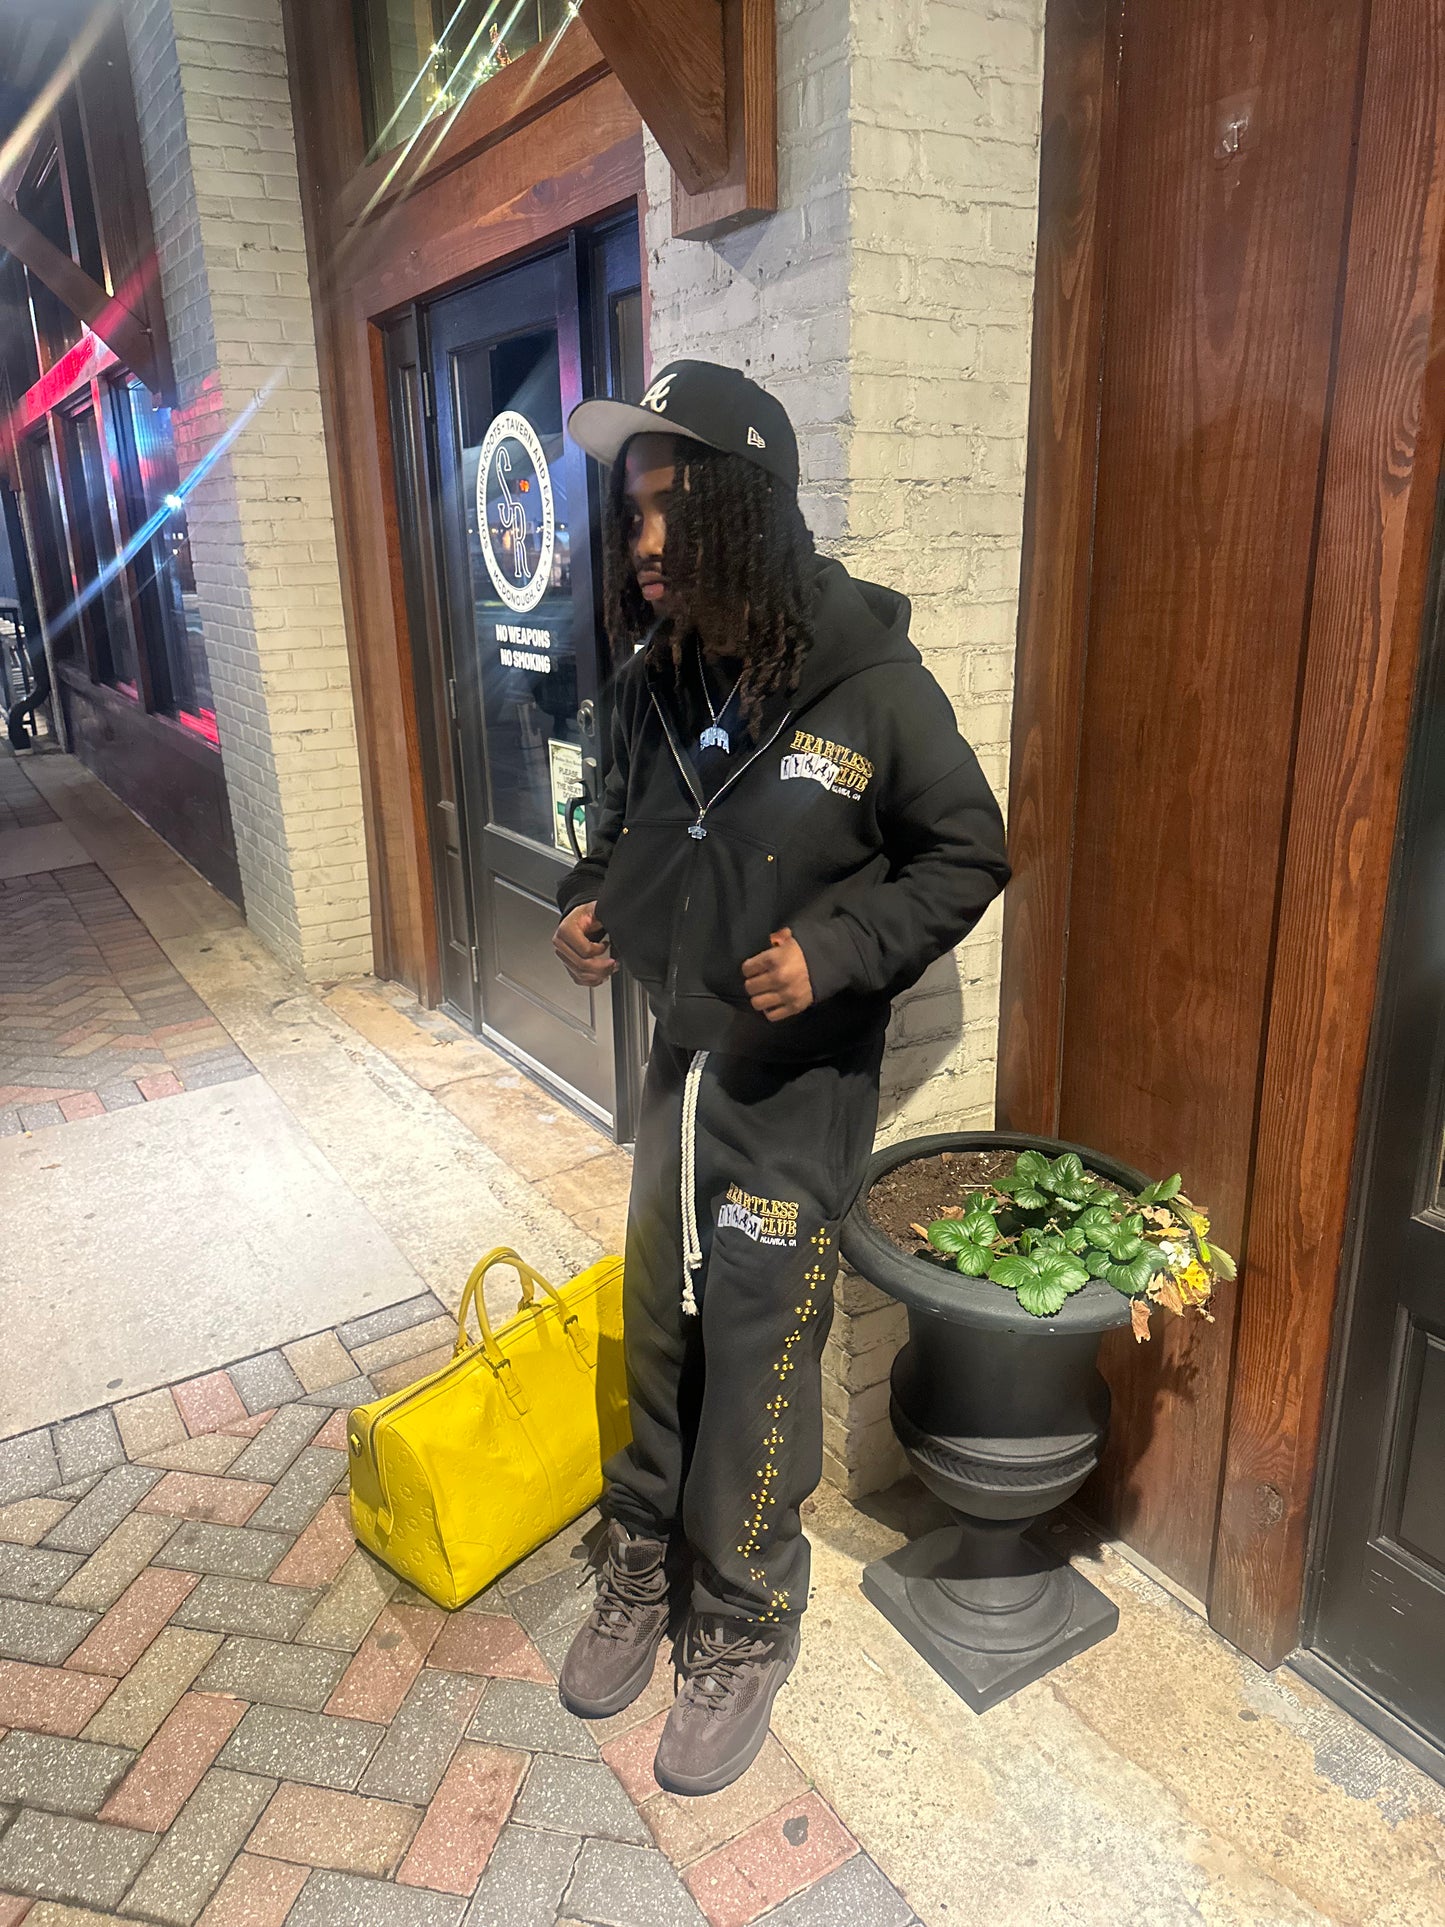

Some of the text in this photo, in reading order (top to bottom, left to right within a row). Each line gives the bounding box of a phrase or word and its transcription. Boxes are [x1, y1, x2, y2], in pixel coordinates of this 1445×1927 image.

[479, 418, 553, 554] SOUTHERN ROOTS TAVERN AND EATERY
[535, 574, 546, 592] GA
[495, 624, 551, 649] NO WEAPONS
[500, 648, 551, 674] NO SMOKING
[790, 730, 875, 779] HEARTLESS
[558, 766, 579, 778] PLEASE
[761, 1216, 797, 1238] CLUB
